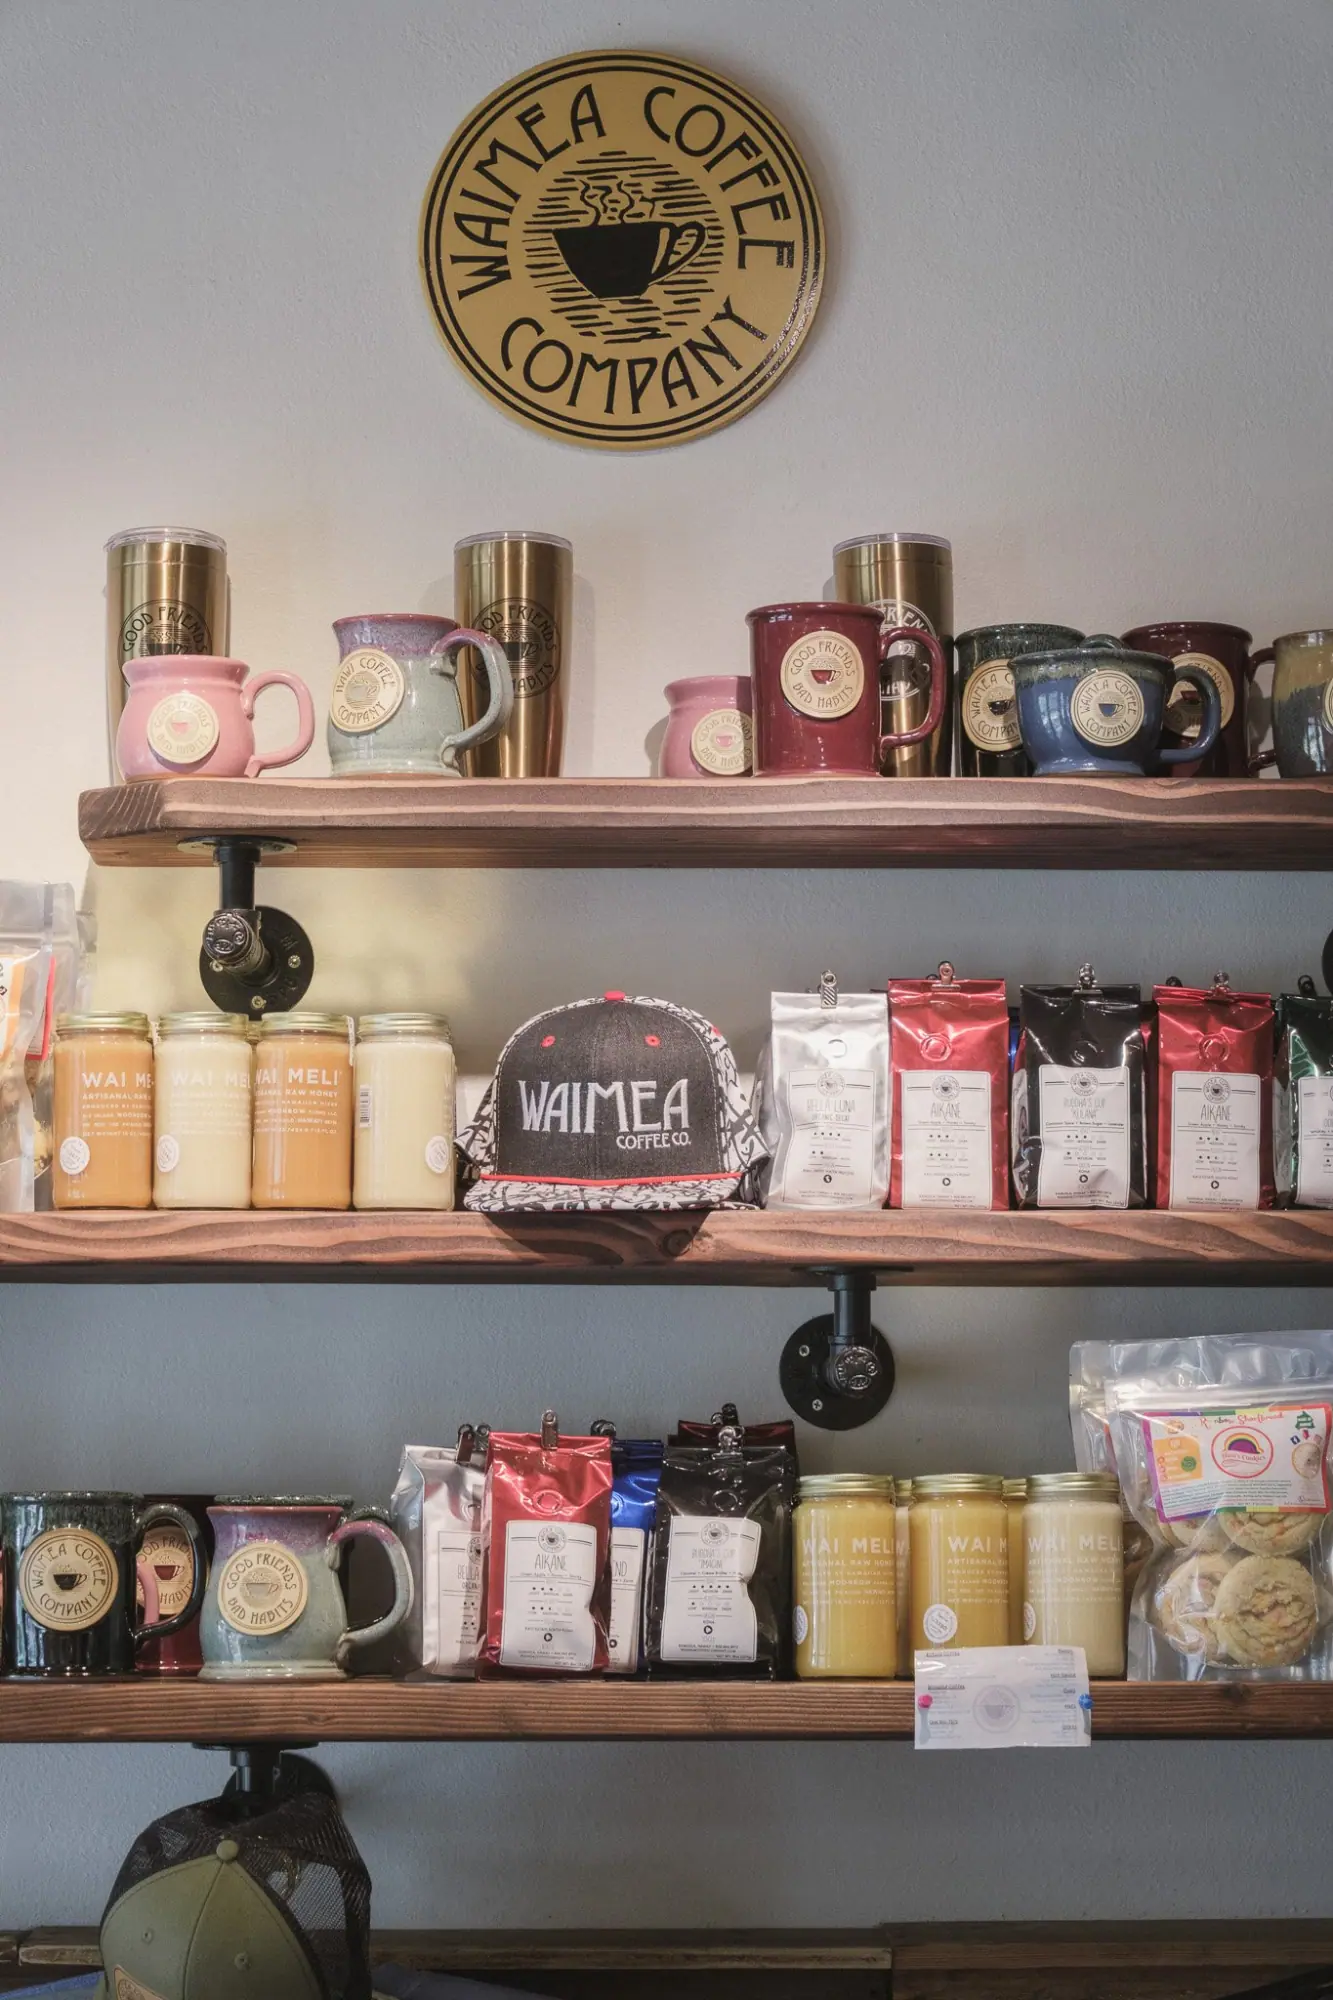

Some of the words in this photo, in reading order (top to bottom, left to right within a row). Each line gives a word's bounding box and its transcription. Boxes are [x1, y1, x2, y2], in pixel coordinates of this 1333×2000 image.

[450, 83, 607, 301] WAIMEA
[643, 85, 796, 270] COFFEE
[501, 295, 768, 415] COMPANY
[123, 612, 154, 652] GOOD
[790, 645, 816, 676] GOOD
[818, 641, 856, 677] FRIENDS
[793, 682, 813, 704] BAD
[817, 684, 854, 709] HABITS
[1080, 679, 1109, 715] WAIMEA
[1114, 680, 1137, 716] COFFEE
[338, 701, 386, 725] COMPANY
[1086, 717, 1131, 737] COMPANY
[81, 1071, 126, 1089] WAI
[171, 1069, 213, 1087] WAI
[288, 1067, 338, 1086] MELI
[517, 1078, 690, 1134] WAIMEA
[1200, 1104, 1233, 1123] AIKANE
[616, 1132, 670, 1150] COFFEE
[672, 1132, 692, 1147] CO.
[802, 1537, 839, 1555] WAI
[947, 1535, 991, 1553] WAI
[31, 1543, 68, 1590] WAIMEA
[75, 1543, 107, 1587] COFFEE
[227, 1558, 254, 1590] GOOD
[256, 1552, 297, 1591] FRIENDS
[39, 1591, 99, 1617] COMPANY
[228, 1596, 246, 1620] BAD
[250, 1598, 294, 1625] HABITS
